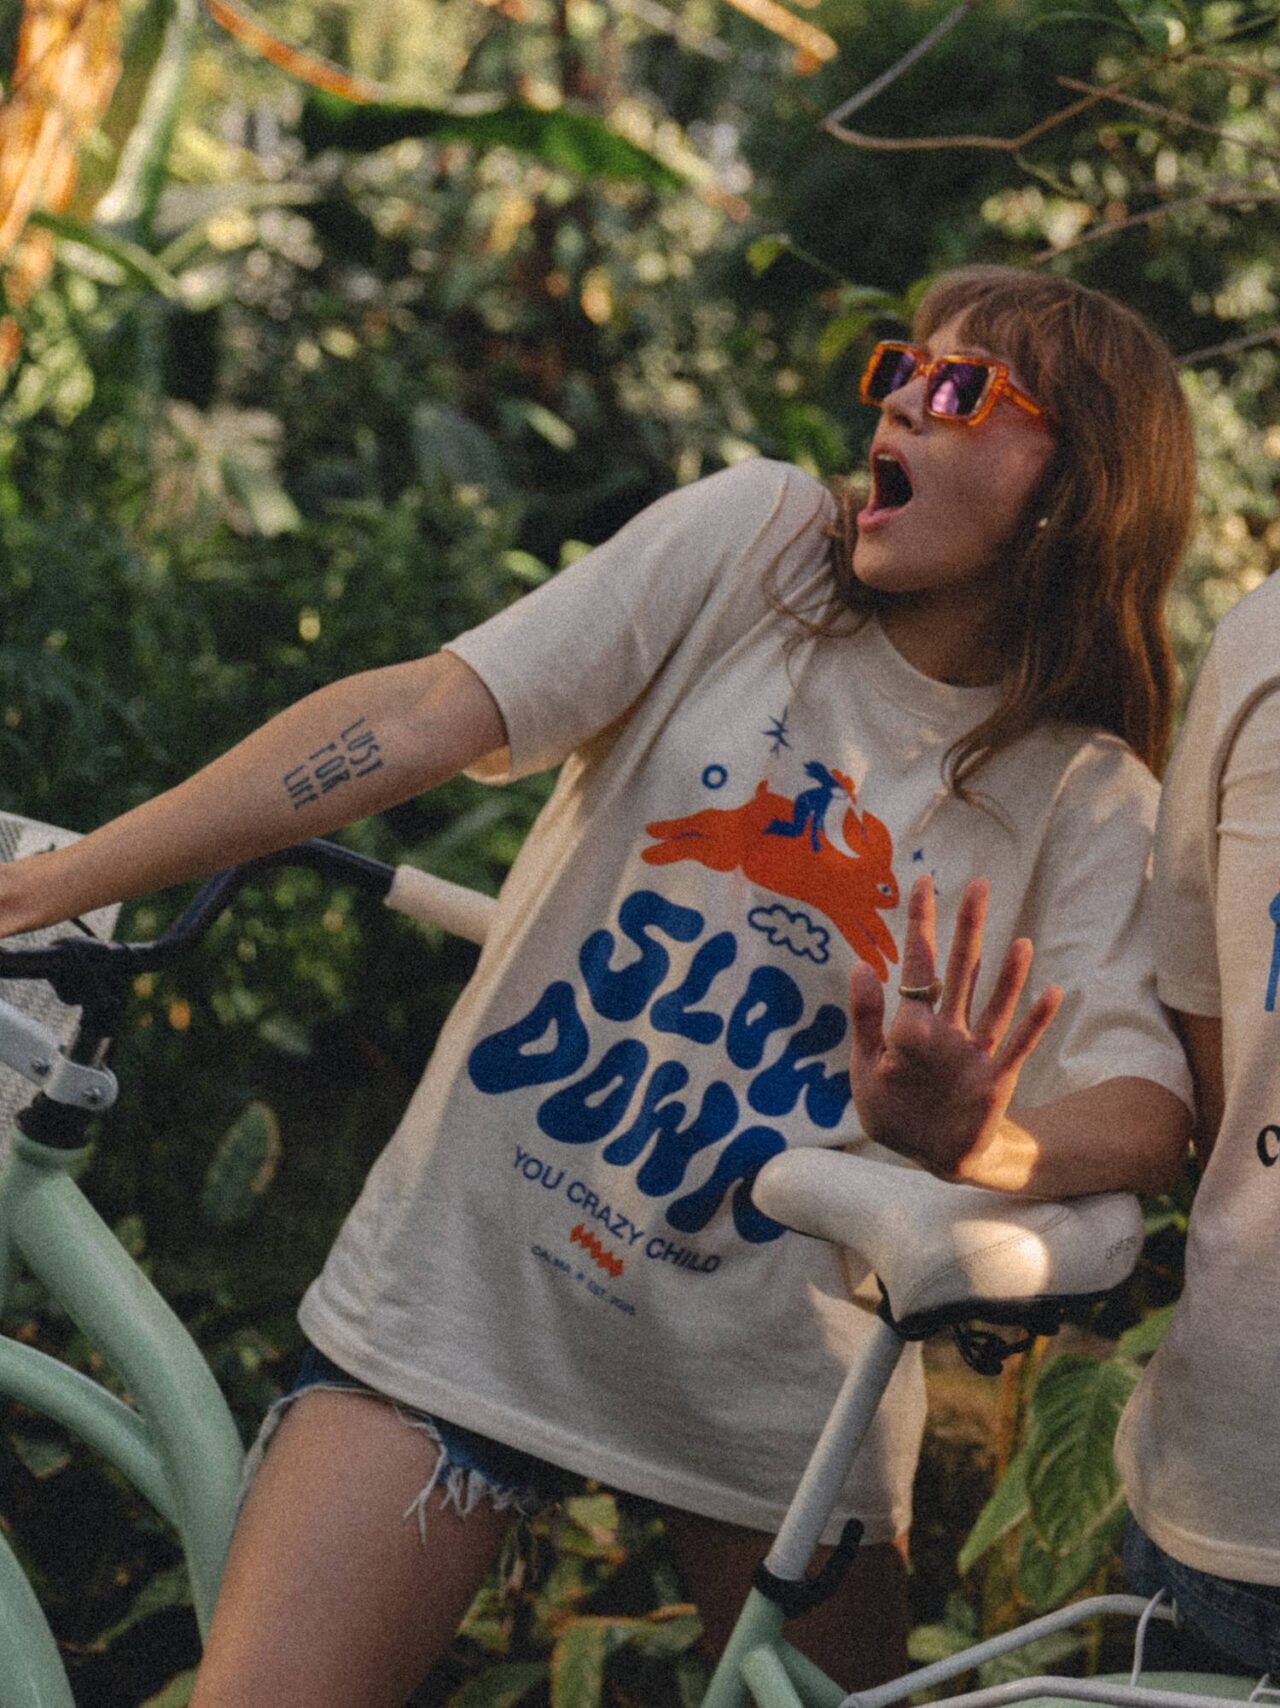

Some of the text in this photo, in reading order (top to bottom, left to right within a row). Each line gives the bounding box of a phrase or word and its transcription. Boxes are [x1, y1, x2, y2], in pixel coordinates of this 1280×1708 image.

[512, 1145, 721, 1274] YOU CRAZY CHILD
